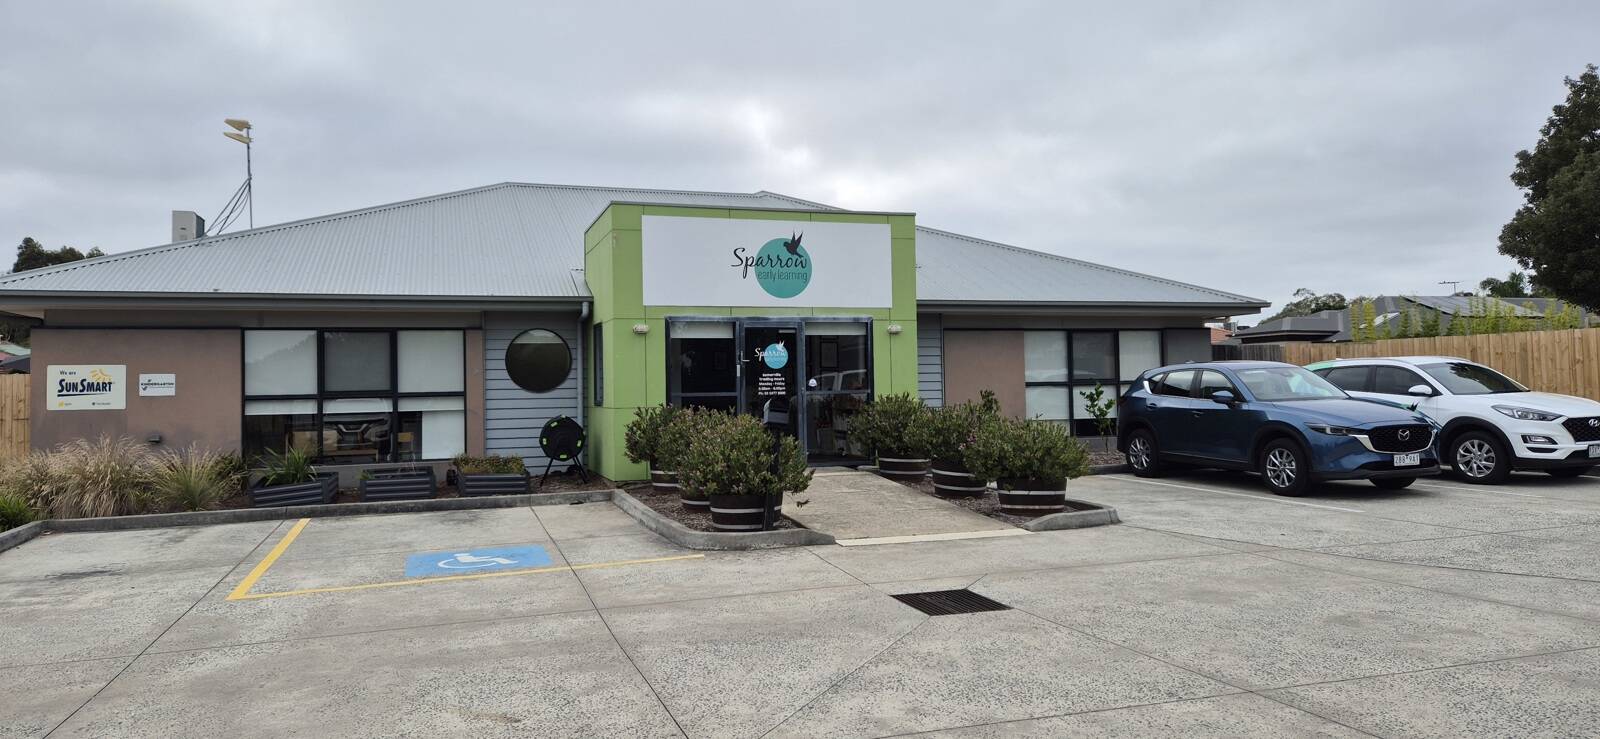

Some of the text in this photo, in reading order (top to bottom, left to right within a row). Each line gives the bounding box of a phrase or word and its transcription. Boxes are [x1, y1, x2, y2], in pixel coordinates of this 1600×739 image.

[731, 247, 807, 279] Sparrow
[758, 269, 808, 283] early learning
[754, 347, 786, 362] Sparrow
